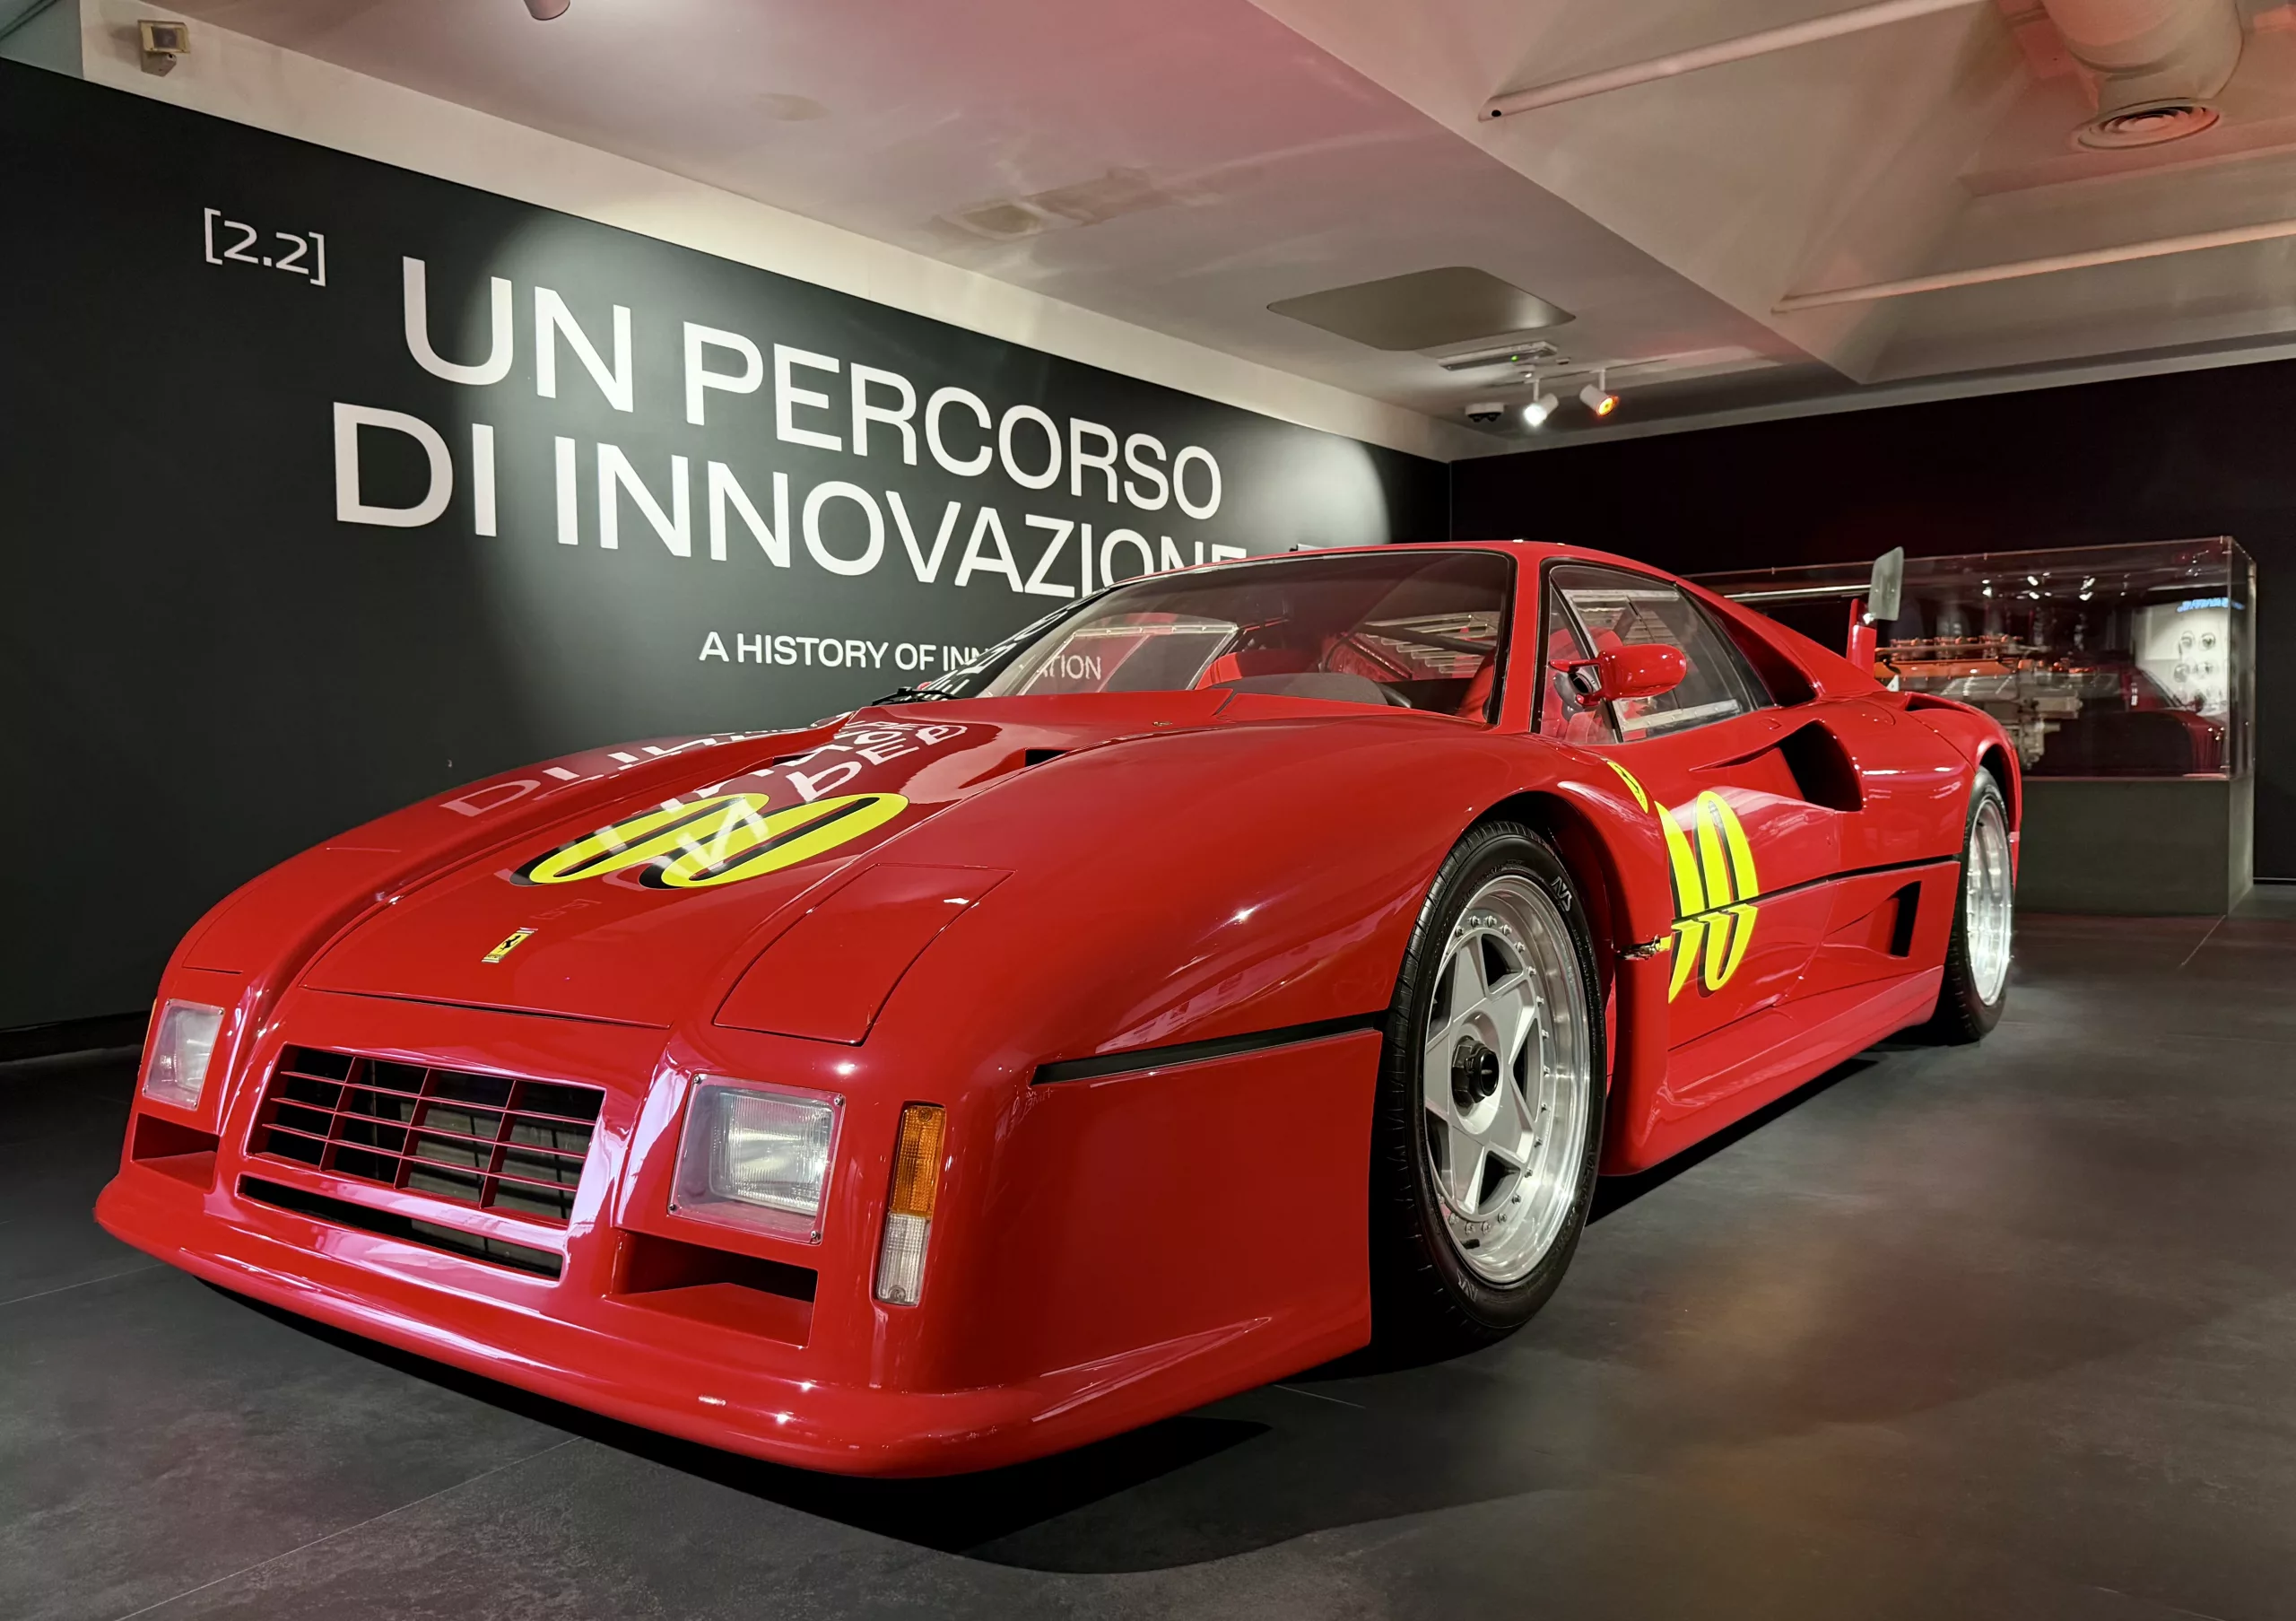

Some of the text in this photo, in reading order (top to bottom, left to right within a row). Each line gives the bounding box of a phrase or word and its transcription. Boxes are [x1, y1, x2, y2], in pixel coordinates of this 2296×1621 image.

[204, 207, 326, 287] [2.2]
[403, 256, 1222, 520] UN PERCORSO
[334, 402, 1247, 599] DI INNOVAZIO
[699, 631, 729, 662] A
[736, 632, 889, 668] HISTORY
[894, 642, 936, 671] OF
